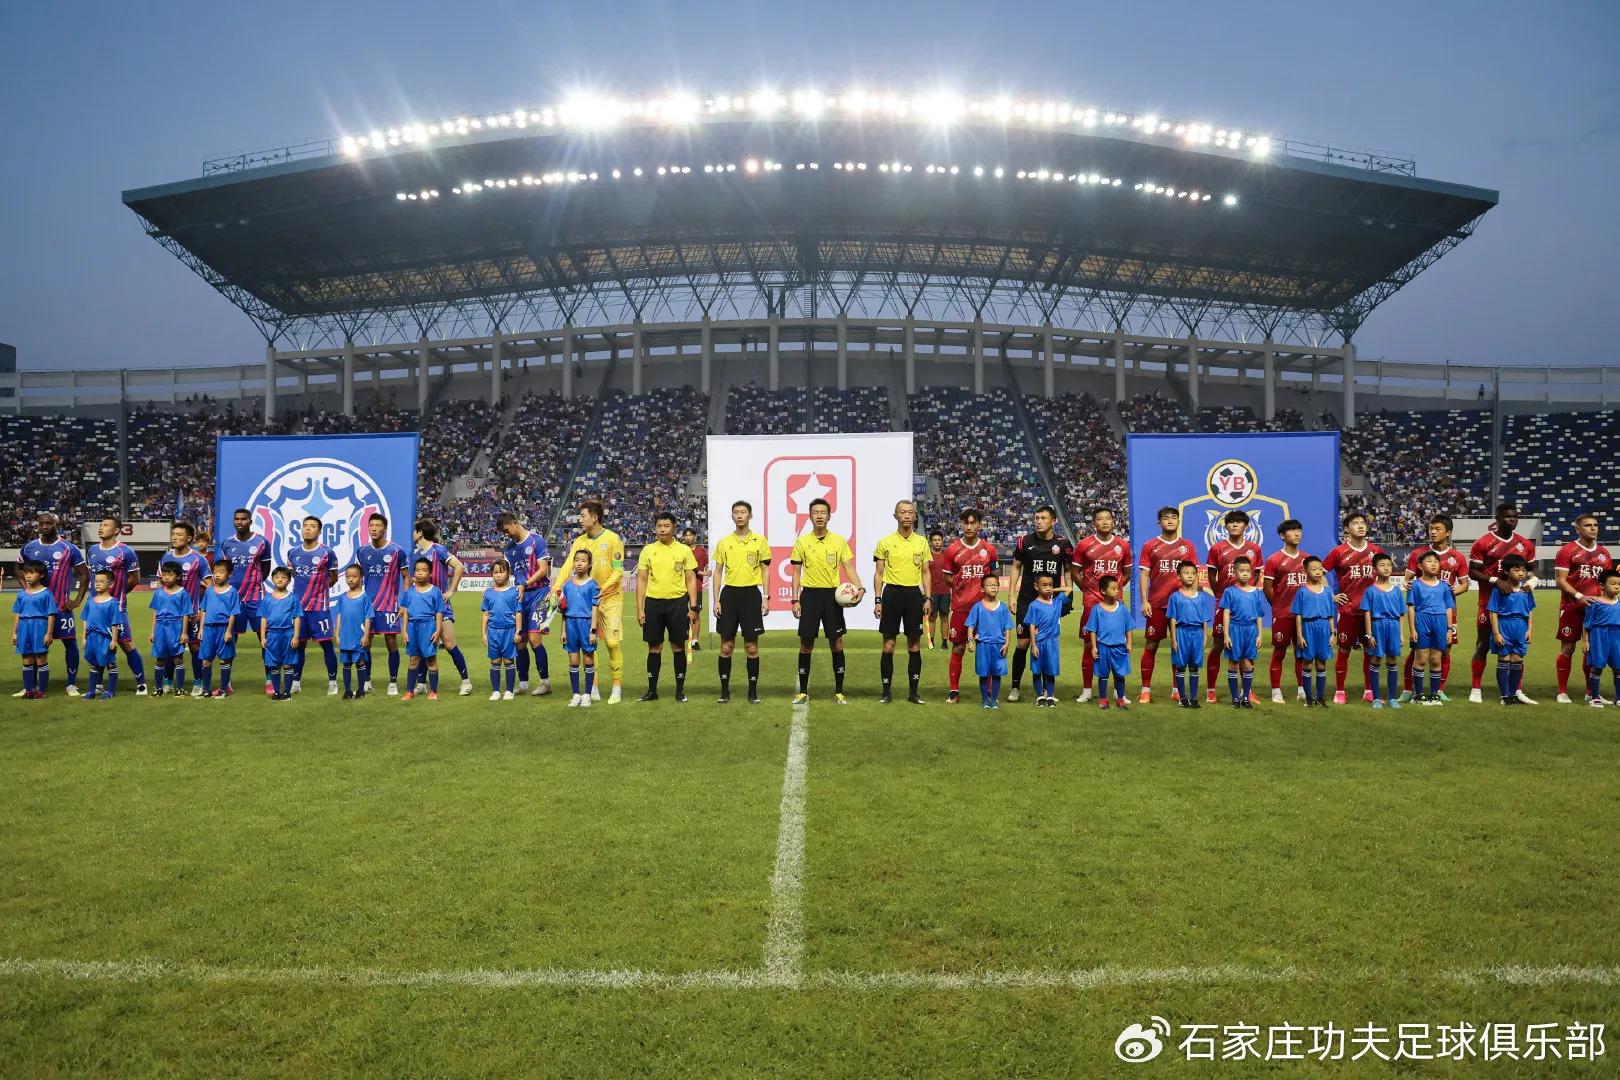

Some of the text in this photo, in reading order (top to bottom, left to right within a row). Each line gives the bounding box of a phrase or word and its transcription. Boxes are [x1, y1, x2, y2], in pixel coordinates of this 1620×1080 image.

[1218, 476, 1246, 491] YB
[961, 565, 984, 577] 延边
[1032, 560, 1057, 572] 延边
[1094, 560, 1118, 572] 延边
[1350, 565, 1373, 577] 延边
[385, 612, 396, 624] 10
[531, 611, 543, 623] 45
[60, 617, 75, 630] 20
[318, 619, 329, 632] 11
